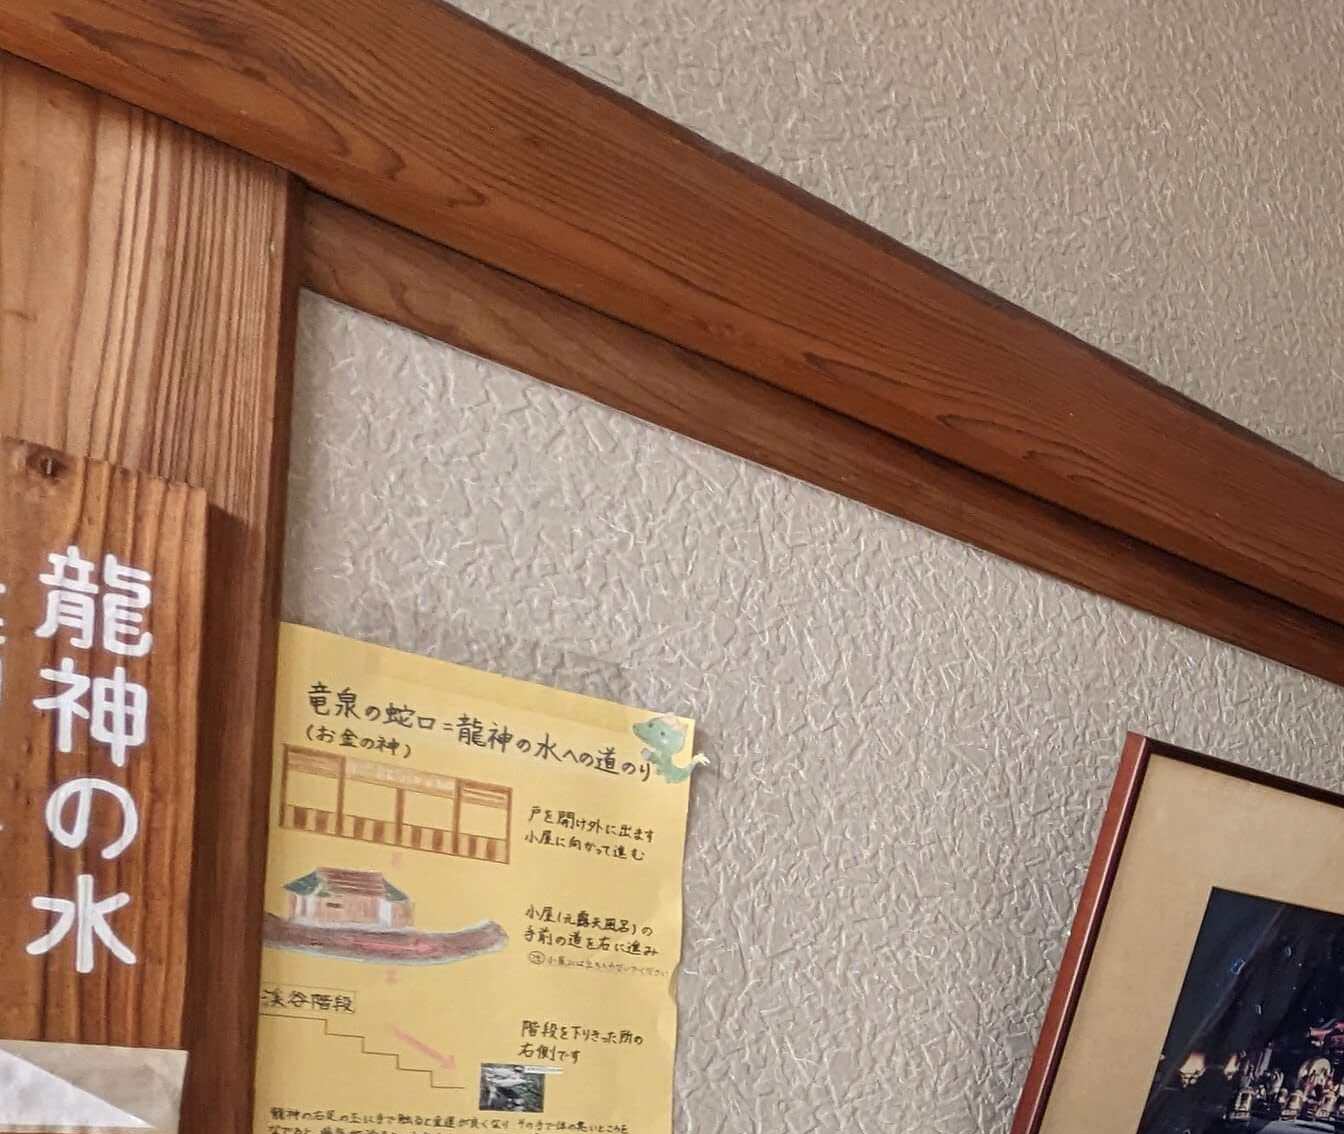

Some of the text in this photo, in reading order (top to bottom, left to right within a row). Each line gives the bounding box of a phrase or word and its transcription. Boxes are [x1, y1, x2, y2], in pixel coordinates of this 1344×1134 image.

[25, 545, 153, 973] 龍神の水
[528, 806, 655, 842] 戸を開け外に出ます
[525, 830, 646, 861] 小屋に向かって進む
[524, 925, 659, 956] 手前の道を右に進み
[521, 1020, 644, 1045] 階段を下りきった所の
[517, 1042, 581, 1064] 右側です
